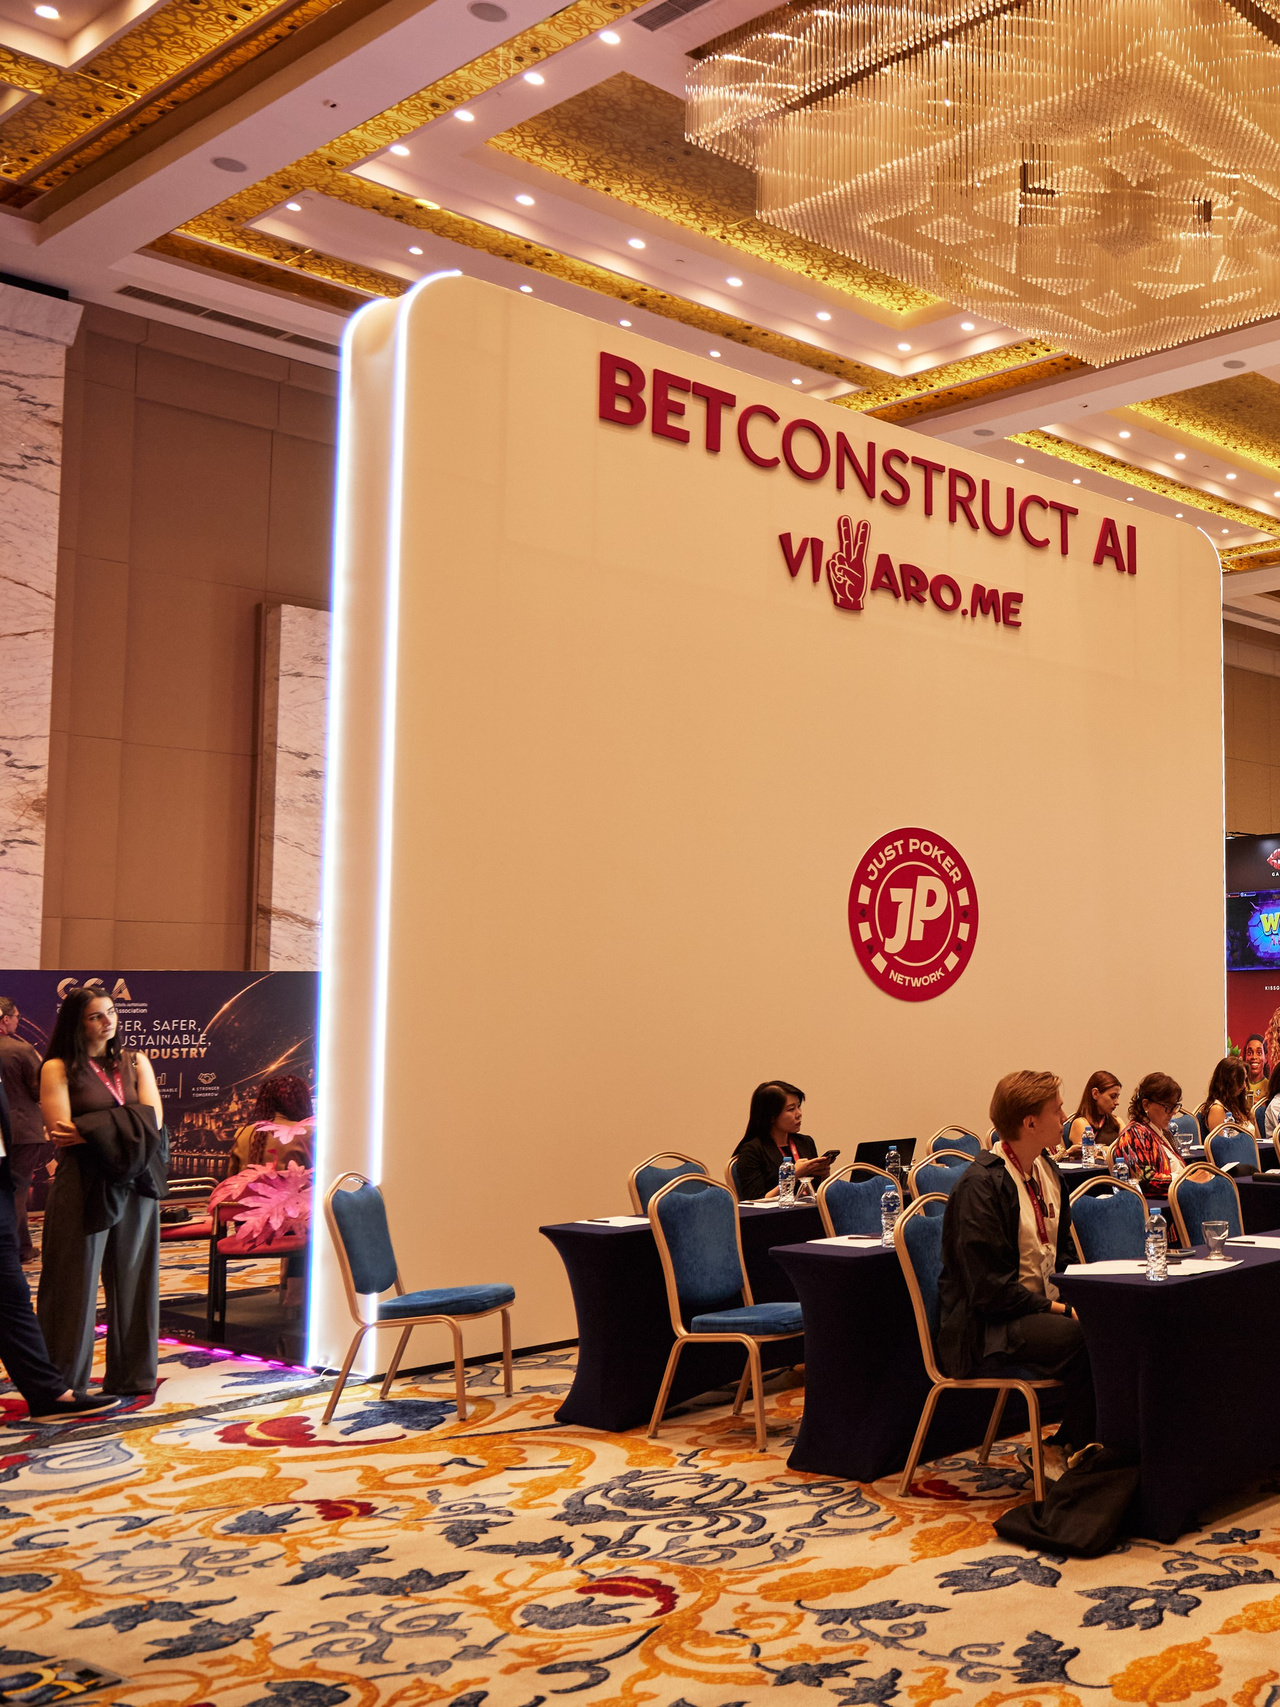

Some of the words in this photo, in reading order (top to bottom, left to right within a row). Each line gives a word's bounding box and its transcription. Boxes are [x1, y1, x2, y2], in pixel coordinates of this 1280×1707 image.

[599, 351, 1079, 555] BETCONSTRUCT
[1093, 517, 1137, 574] AI
[866, 839, 904, 881] JUST
[908, 838, 962, 884] POKER
[884, 875, 948, 954] JP
[889, 967, 945, 987] NETWORK
[121, 1034, 211, 1047] USTAINABLE,
[153, 1019, 201, 1032] SAFER,
